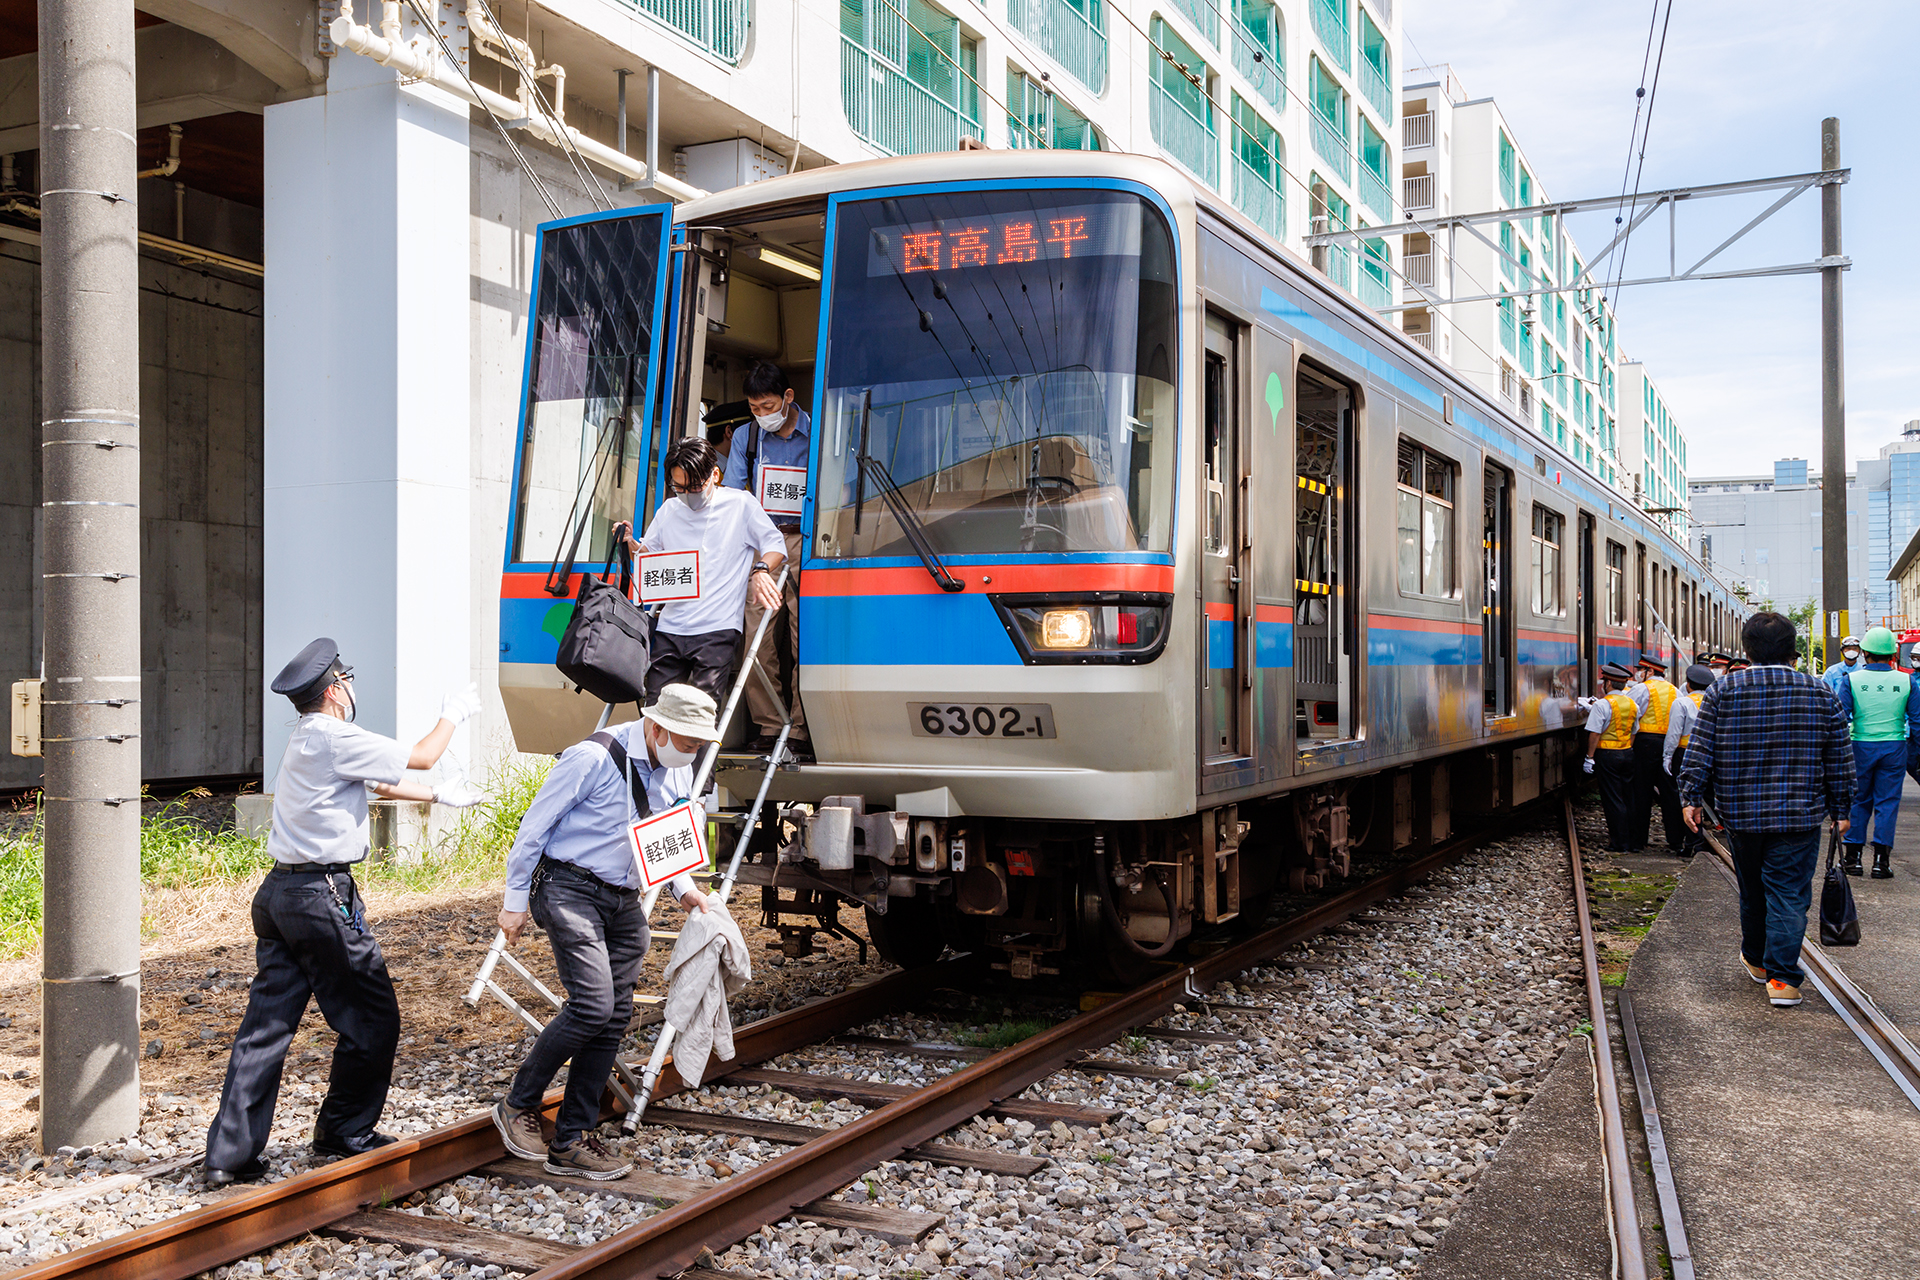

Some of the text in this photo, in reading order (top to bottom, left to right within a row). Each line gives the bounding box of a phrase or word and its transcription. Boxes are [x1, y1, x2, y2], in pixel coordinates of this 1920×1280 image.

[903, 215, 1089, 273] 西高島平
[643, 566, 694, 588] 軽傷者
[644, 827, 694, 865] 軽傷者
